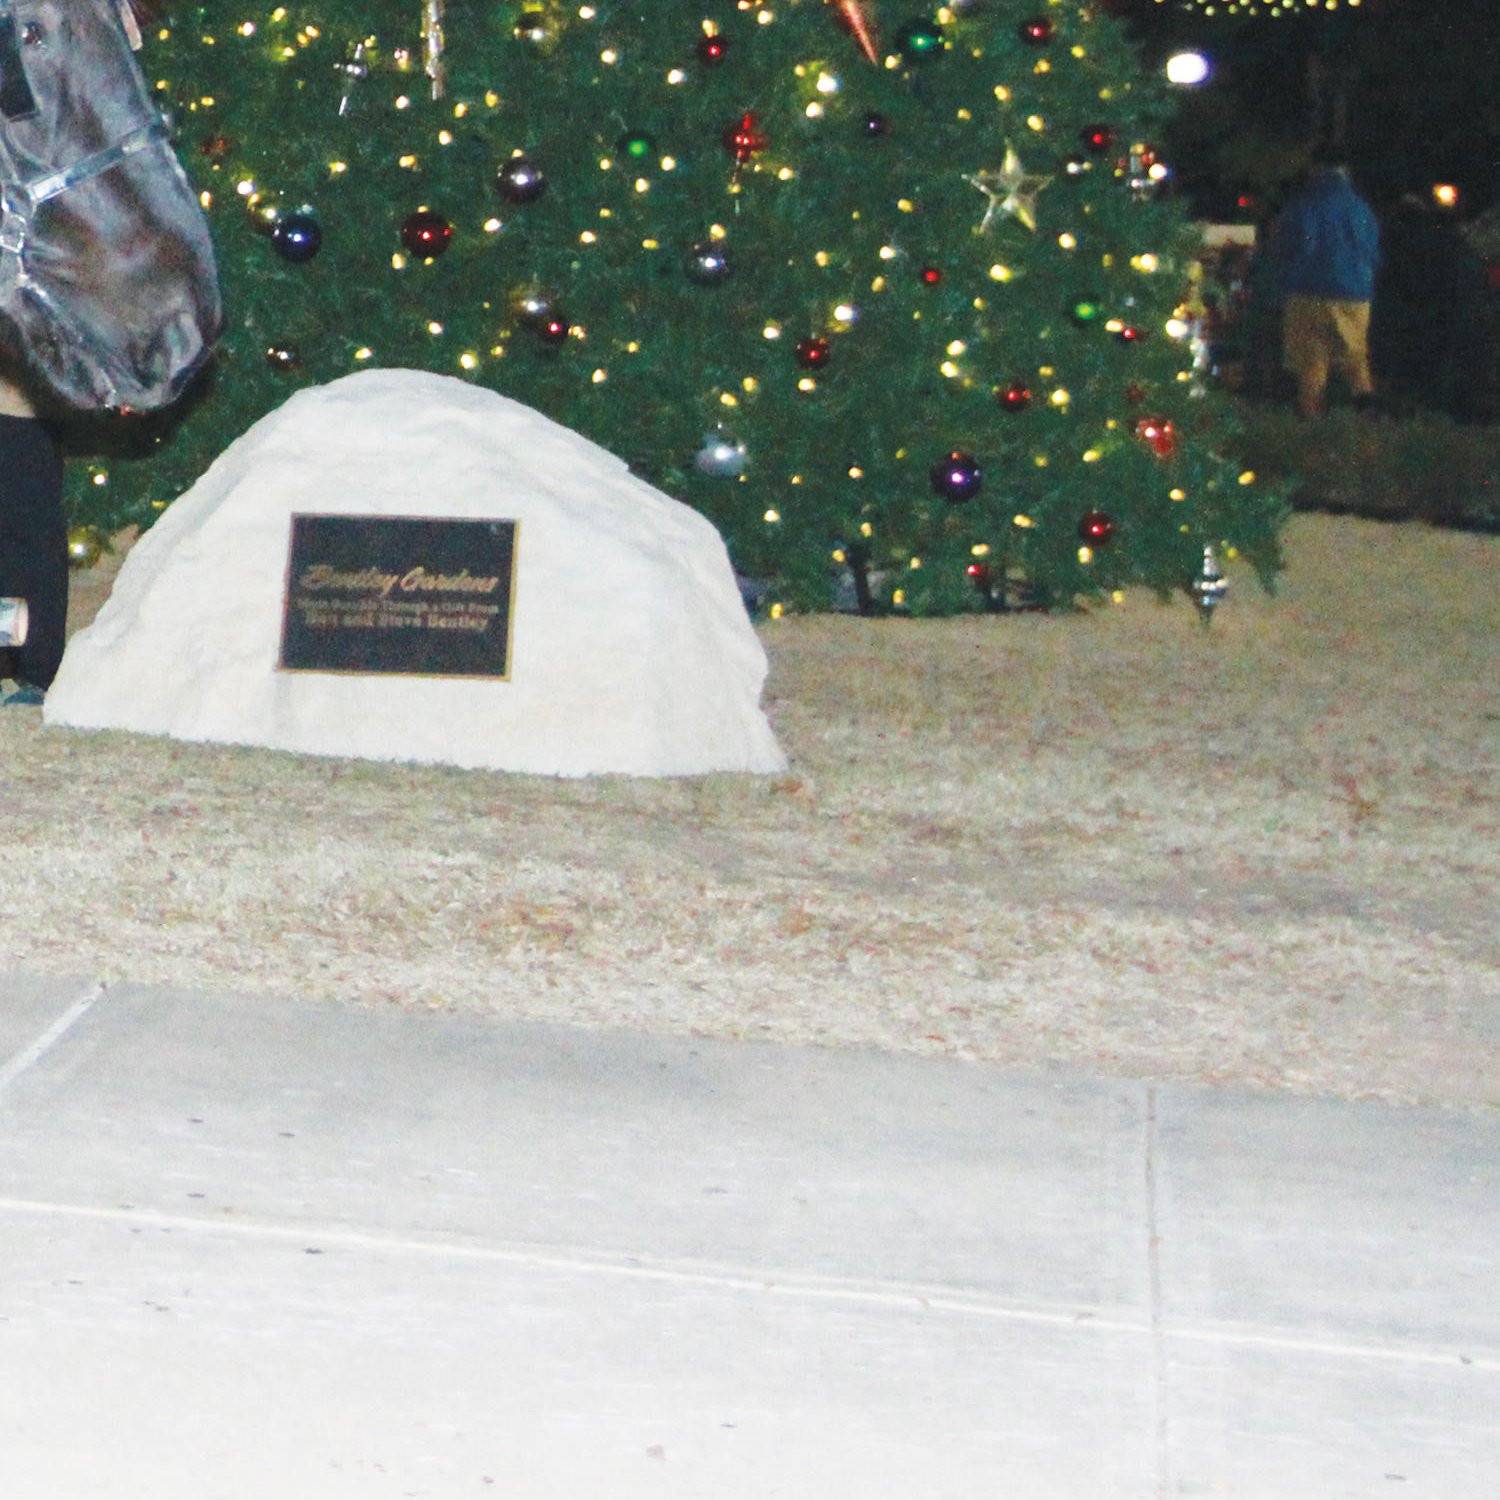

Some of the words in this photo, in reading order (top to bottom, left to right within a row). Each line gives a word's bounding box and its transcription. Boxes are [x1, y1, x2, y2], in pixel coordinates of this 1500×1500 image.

[299, 564, 398, 597] Bentley
[400, 566, 499, 592] Gardens
[342, 612, 373, 627] and
[427, 614, 488, 632] Bentley
